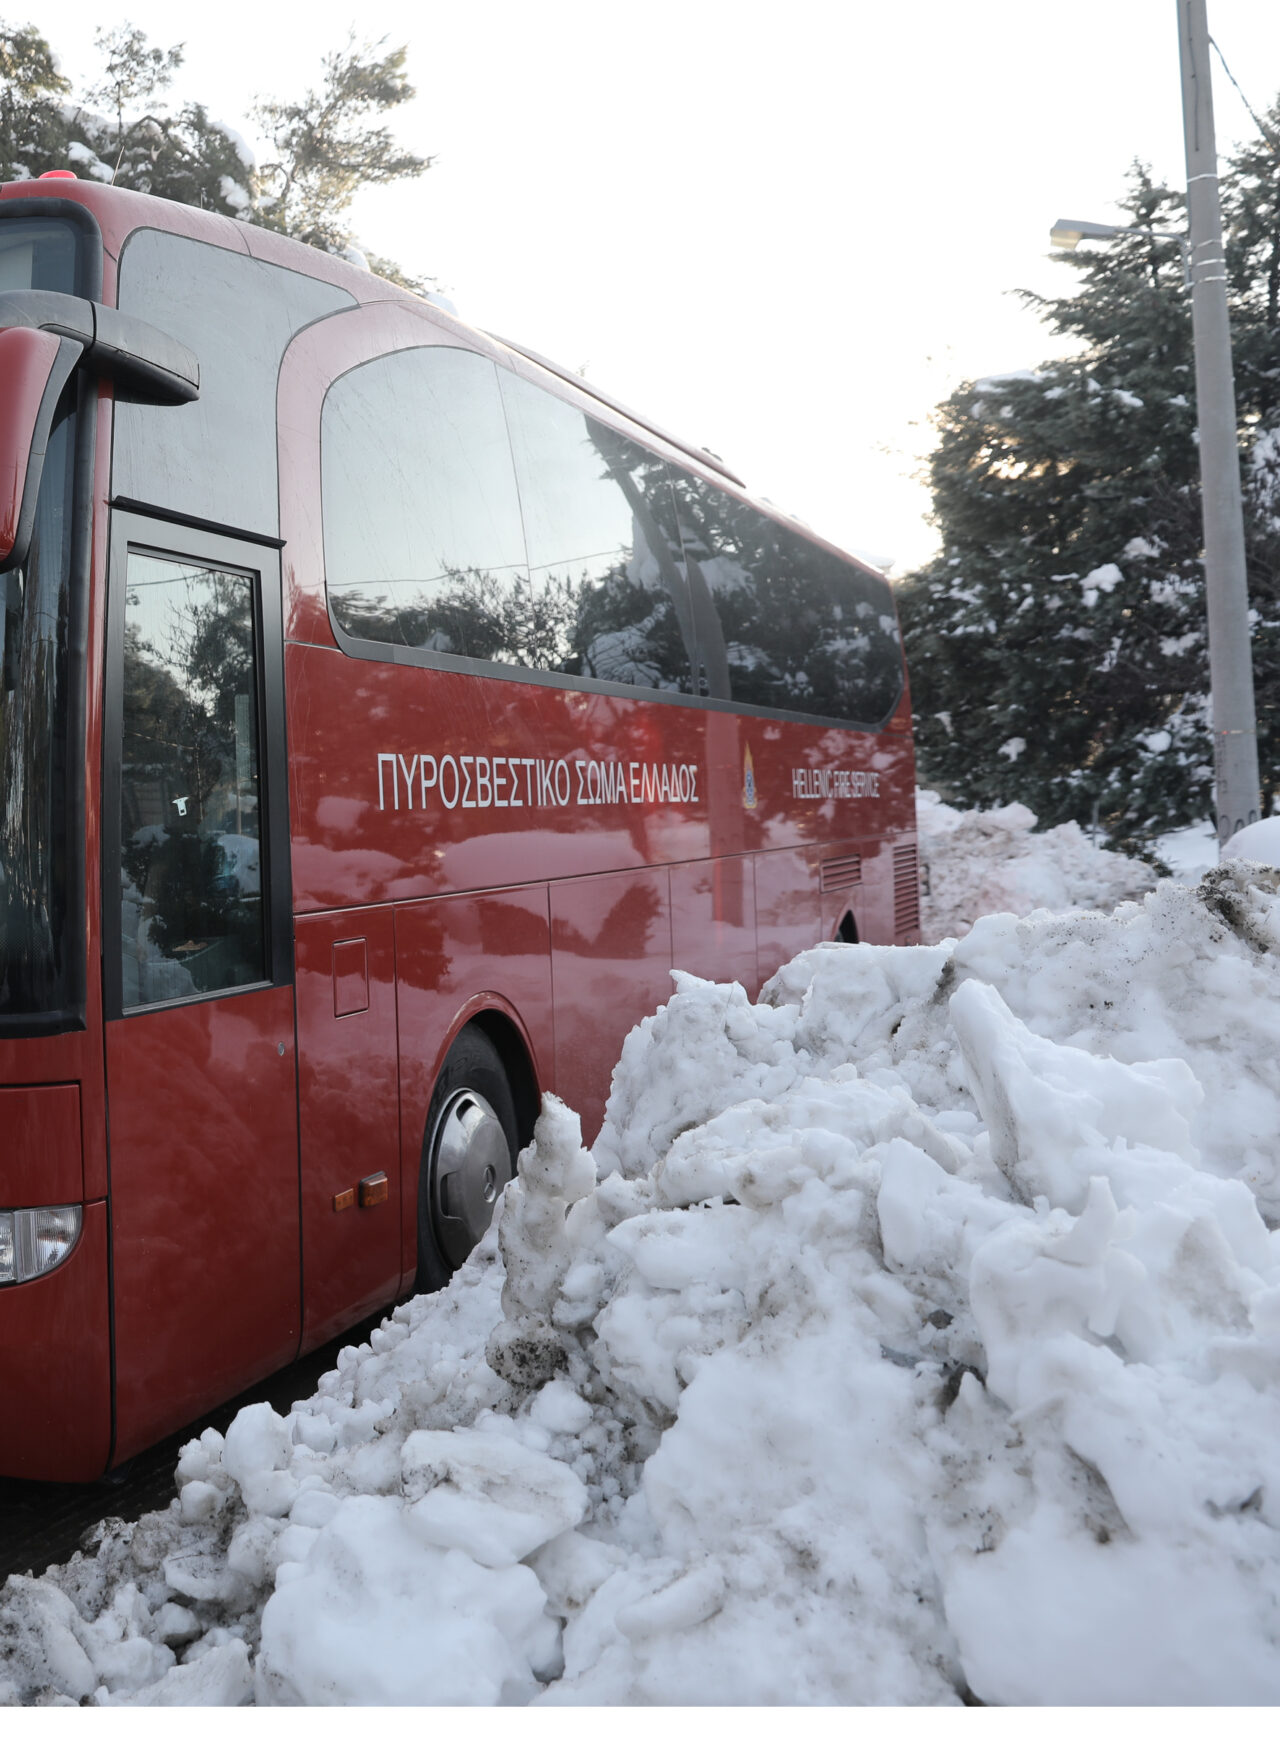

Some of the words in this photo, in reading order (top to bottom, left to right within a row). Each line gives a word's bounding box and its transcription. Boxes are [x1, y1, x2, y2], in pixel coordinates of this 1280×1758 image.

[377, 752, 571, 811] ΠΥΡΟΣΒΕΣΤΙΚΟ
[576, 760, 629, 804] ΣΩΜΑ
[629, 762, 699, 803] ΕΛΛΑΔΟΣ
[792, 767, 833, 799] HELLENIC
[851, 770, 881, 799] SERVICE
